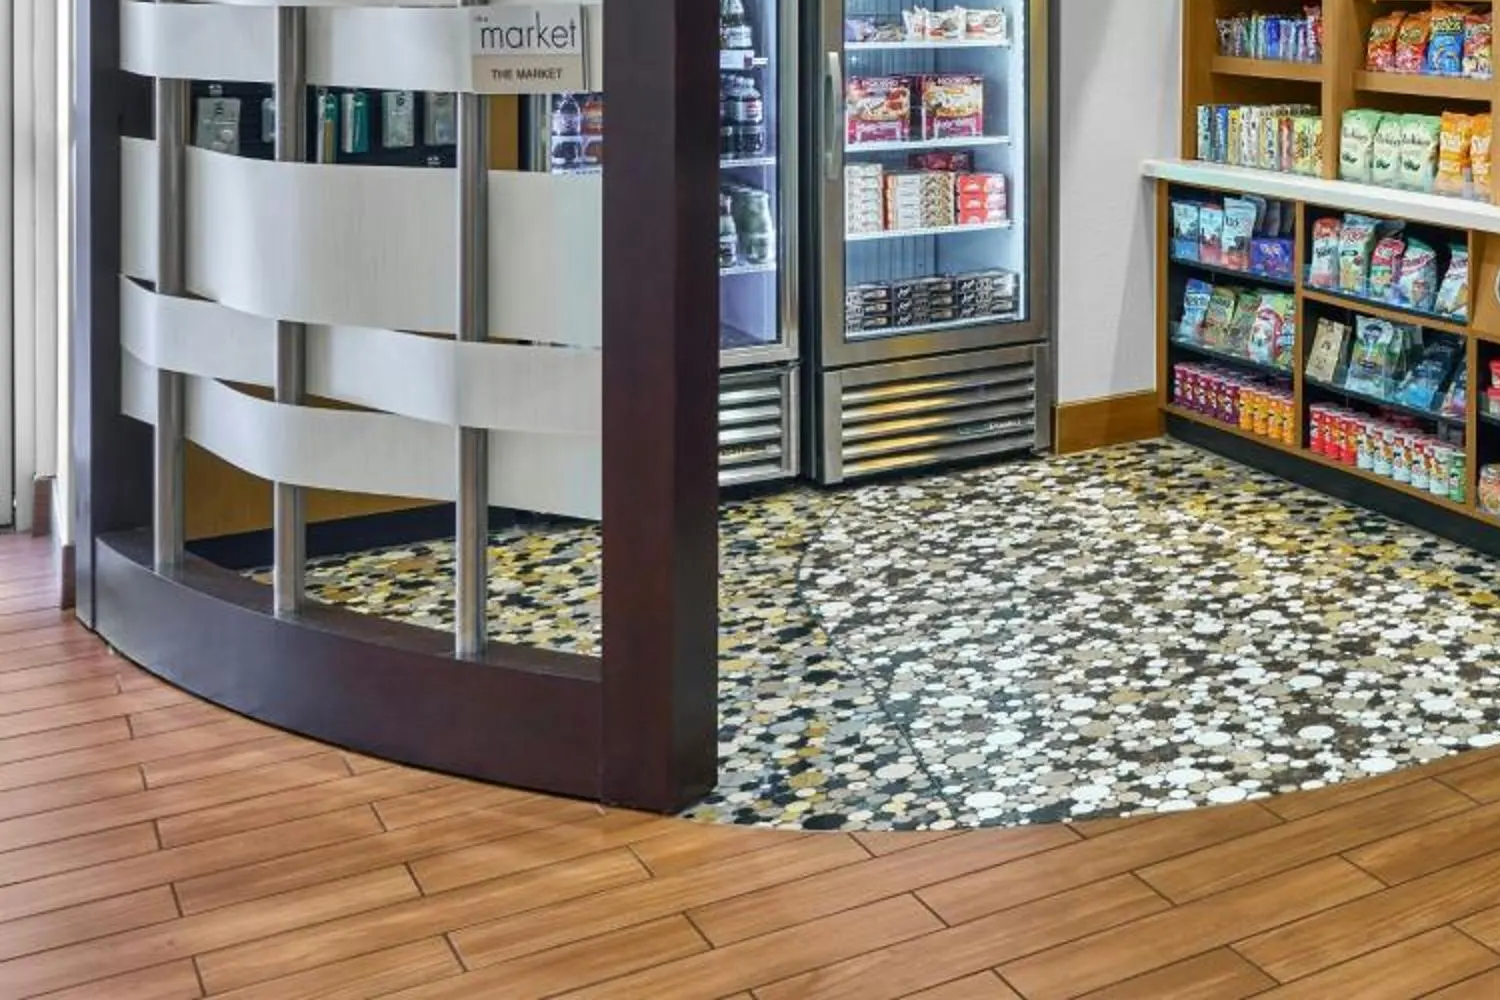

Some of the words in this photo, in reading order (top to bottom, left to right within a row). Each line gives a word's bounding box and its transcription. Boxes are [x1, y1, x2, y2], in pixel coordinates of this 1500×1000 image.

[480, 10, 577, 49] market
[491, 68, 513, 80] THE
[515, 66, 563, 80] MARKET
